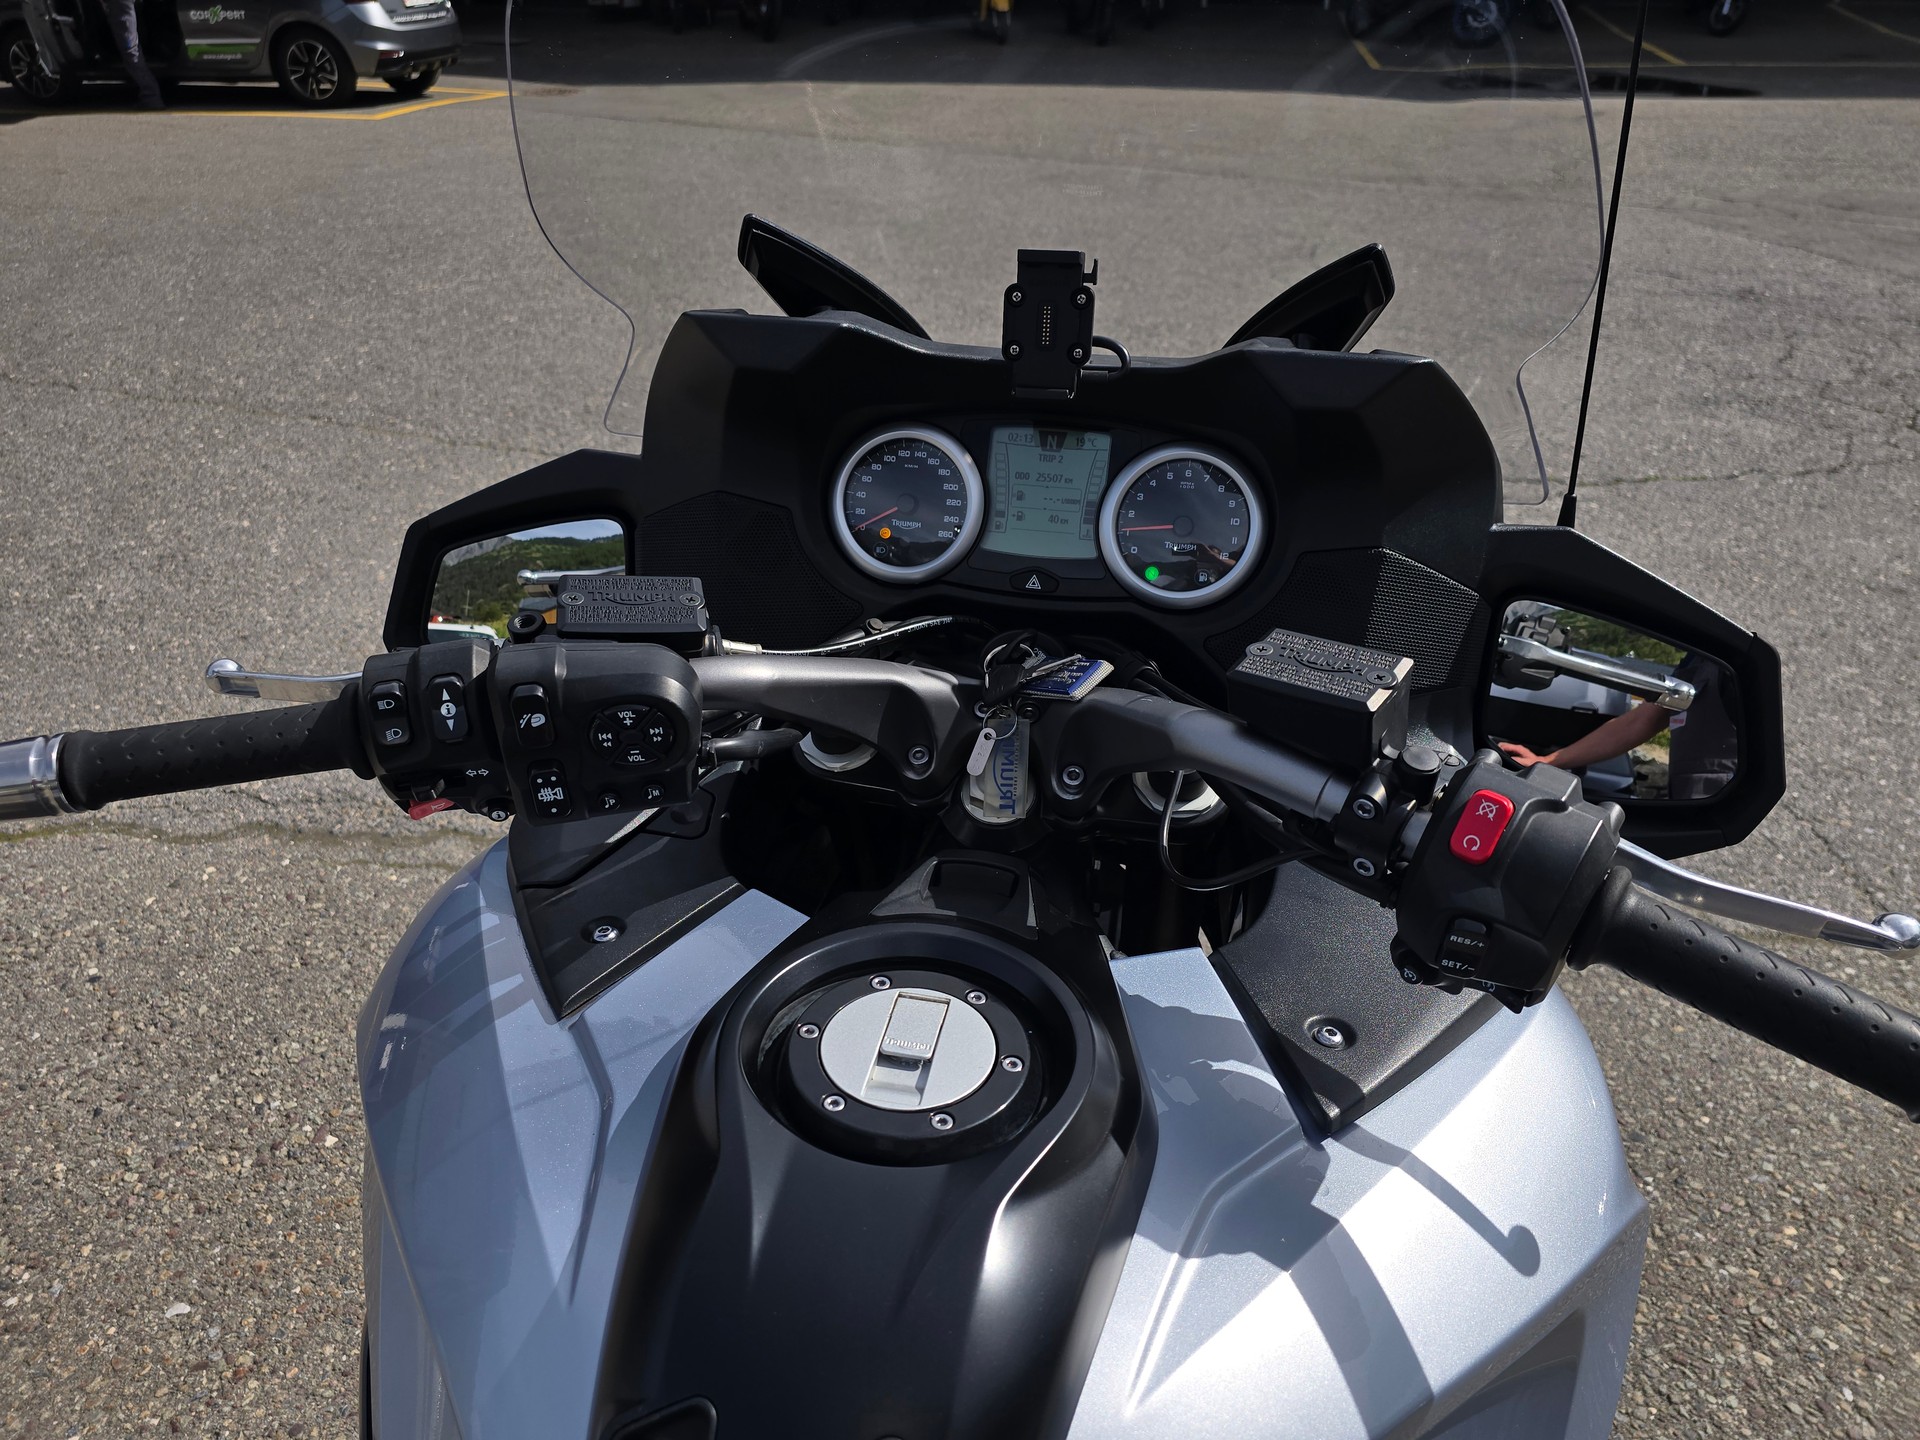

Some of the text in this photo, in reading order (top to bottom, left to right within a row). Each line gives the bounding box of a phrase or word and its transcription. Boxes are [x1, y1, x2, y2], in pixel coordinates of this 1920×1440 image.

[1008, 432, 1034, 443] 02:13
[1046, 434, 1058, 450] N
[883, 455, 897, 463] 100
[927, 458, 940, 466] 160
[1038, 454, 1064, 464] TRIP 2
[938, 468, 951, 476] 180
[1166, 472, 1174, 480] 5
[862, 475, 872, 483] 60
[1035, 473, 1063, 483] 25507
[943, 483, 959, 491] 200
[1150, 479, 1157, 487] 4
[1218, 485, 1225, 493] 8
[946, 499, 962, 507] 220
[855, 507, 866, 515] 20
[1128, 510, 1135, 518] 2
[1048, 515, 1059, 524] 40
[1230, 518, 1240, 526] 10
[891, 518, 922, 530] TRIUMPH
[938, 530, 954, 538] 260
[1131, 546, 1138, 554] 0
[1164, 541, 1197, 552] TRIUMPH
[1219, 552, 1229, 560] 12
[588, 591, 676, 605] TRIUMPH
[1280, 646, 1368, 676] TRIUMPH
[618, 711, 636, 719] VOL
[1450, 935, 1485, 948] RES/+
[1441, 959, 1475, 971] SET/-
